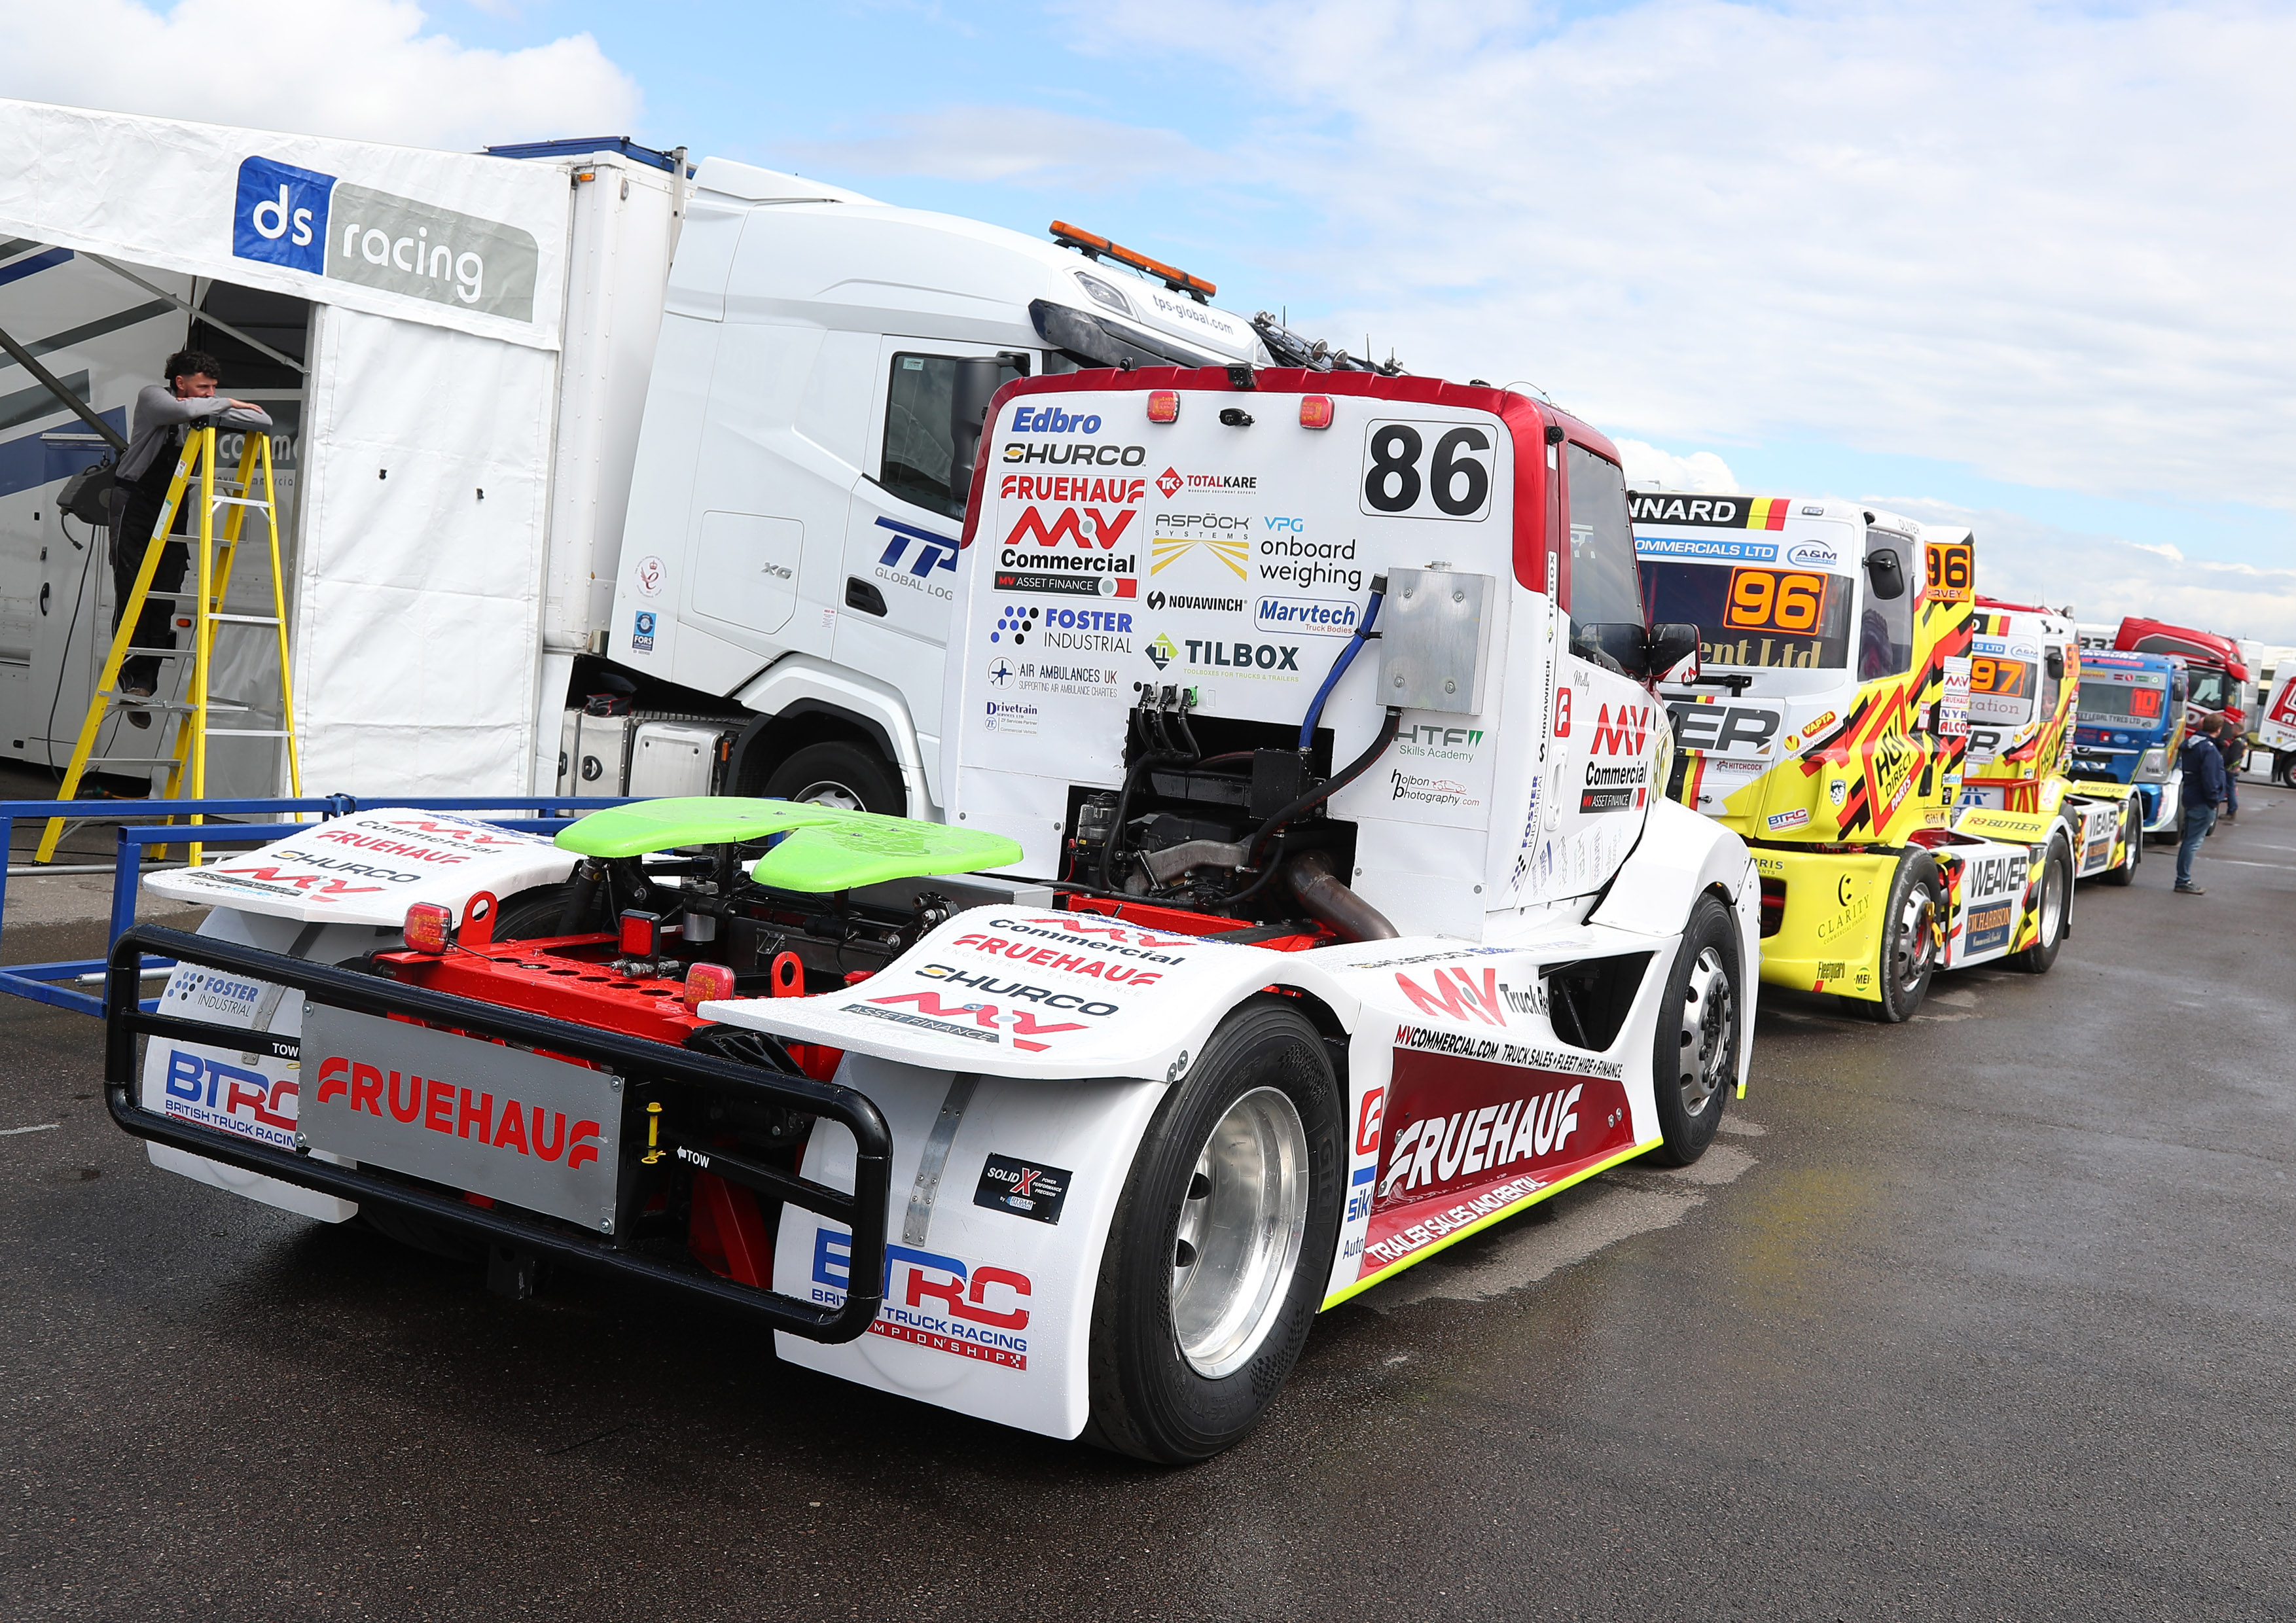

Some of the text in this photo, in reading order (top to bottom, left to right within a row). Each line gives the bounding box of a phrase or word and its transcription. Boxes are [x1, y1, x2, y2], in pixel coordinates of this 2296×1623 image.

[253, 184, 483, 304] ds racing
[1153, 294, 1234, 335] tps-global.com
[1011, 407, 1102, 434] Edbro
[1003, 443, 1145, 466] SHURCO
[1187, 475, 1257, 488] TOTALKARE
[1365, 424, 1490, 516] 86
[1000, 475, 1145, 503] FRUEHAUF
[1004, 506, 1138, 549] MV
[1155, 529, 1248, 540] SYSTEMS
[1156, 513, 1249, 530] ASPÖCK
[1264, 516, 1303, 532] VPG
[1261, 535, 1355, 560] onboard
[1744, 545, 1774, 558] LTD
[1797, 550, 1837, 560] A&M
[1001, 549, 1136, 573] Commercial
[1928, 547, 1967, 588] 96
[875, 567, 923, 591] GLOBAL
[998, 576, 1094, 590] MV ASSET FINANCE
[1260, 561, 1361, 592] weighing
[1169, 595, 1243, 611] NOVAWINCH
[1259, 600, 1355, 626] Marvtech
[1731, 571, 1820, 629] 96
[1046, 608, 1133, 633] FOSTER
[1305, 623, 1352, 633] Truck Bodies
[634, 635, 653, 645] FORS
[1045, 632, 1132, 654] INDUSTRIAL
[1986, 644, 2003, 653] LTD
[1185, 640, 1299, 671] TILBOX
[1759, 639, 1822, 668] Ltd
[1019, 664, 1117, 685] AIR AMBULANCES UK
[1183, 668, 1219, 677] TOOLBOXES
[1235, 671, 1261, 679] TRUCKS
[1971, 660, 2022, 692] 97
[1018, 681, 1117, 698] SUPPORTING AIR AMBULANCE CHARITIES
[1542, 660, 1551, 738] NOVAWINCH
[986, 702, 1037, 715] Drivetrain
[1393, 724, 1467, 746] HTF
[1803, 712, 1833, 734] VAPTA
[1399, 744, 1474, 763] Skills Academy
[1788, 721, 1842, 760] WORKSHOP MANAGEMENT
[1875, 715, 1905, 788] HGV
[1586, 761, 1648, 786] Commercial
[1886, 751, 1911, 798] DIRECT
[1583, 794, 1629, 807] MV ASSET FINANCE
[1890, 775, 1911, 812] PARTS
[1522, 776, 1538, 848] FOSTER
[1528, 775, 1543, 847] INDUSTRIAL
[1768, 809, 1806, 825] BTRC
[1925, 813, 1938, 824] Giti
[356, 821, 504, 854] Commercial
[1987, 819, 2041, 832] BUTLER
[316, 830, 471, 864] FRUEHAUF
[270, 850, 421, 883] SHURCO
[1971, 857, 2027, 898] WEAVER
[1818, 895, 1869, 938] CLARITY
[1823, 914, 1867, 945] COMMERCIAL FINANCE
[989, 919, 1186, 966] Commercial
[942, 946, 1143, 998] ENGINEERING EXCELLENCE
[952, 934, 1164, 986] FRUEHAUF
[204, 977, 259, 1003] FOSTER
[916, 963, 1119, 1018] SHURCO
[1856, 974, 1870, 984] MEI
[198, 993, 251, 1018] INDUSTRIAL
[1499, 983, 1539, 1015] Truck
[846, 1005, 997, 1042] ASSET FINANCE
[272, 1043, 299, 1058] TOW
[1394, 1024, 1624, 1080] MVCOMMERCIAL.COM TRUCK SALES FLEET HIRE FINANCE
[166, 1049, 299, 1132] BTRC
[165, 1099, 209, 1122] BRITISH
[212, 1114, 253, 1137] TRUCK
[317, 1056, 600, 1170] FRUEHAUF
[1377, 1082, 1584, 1198] FRUEHAUF
[686, 1149, 709, 1168] TOW
[1032, 1181, 1063, 1192] PERFORMANCE
[1035, 1188, 1056, 1197] PRECISION
[1011, 1197, 1033, 1206] RYDAM
[1365, 1176, 1549, 1263] TRAILER SALES AND RENTAL
[884, 1306, 1028, 1352] TRUCK RACING
